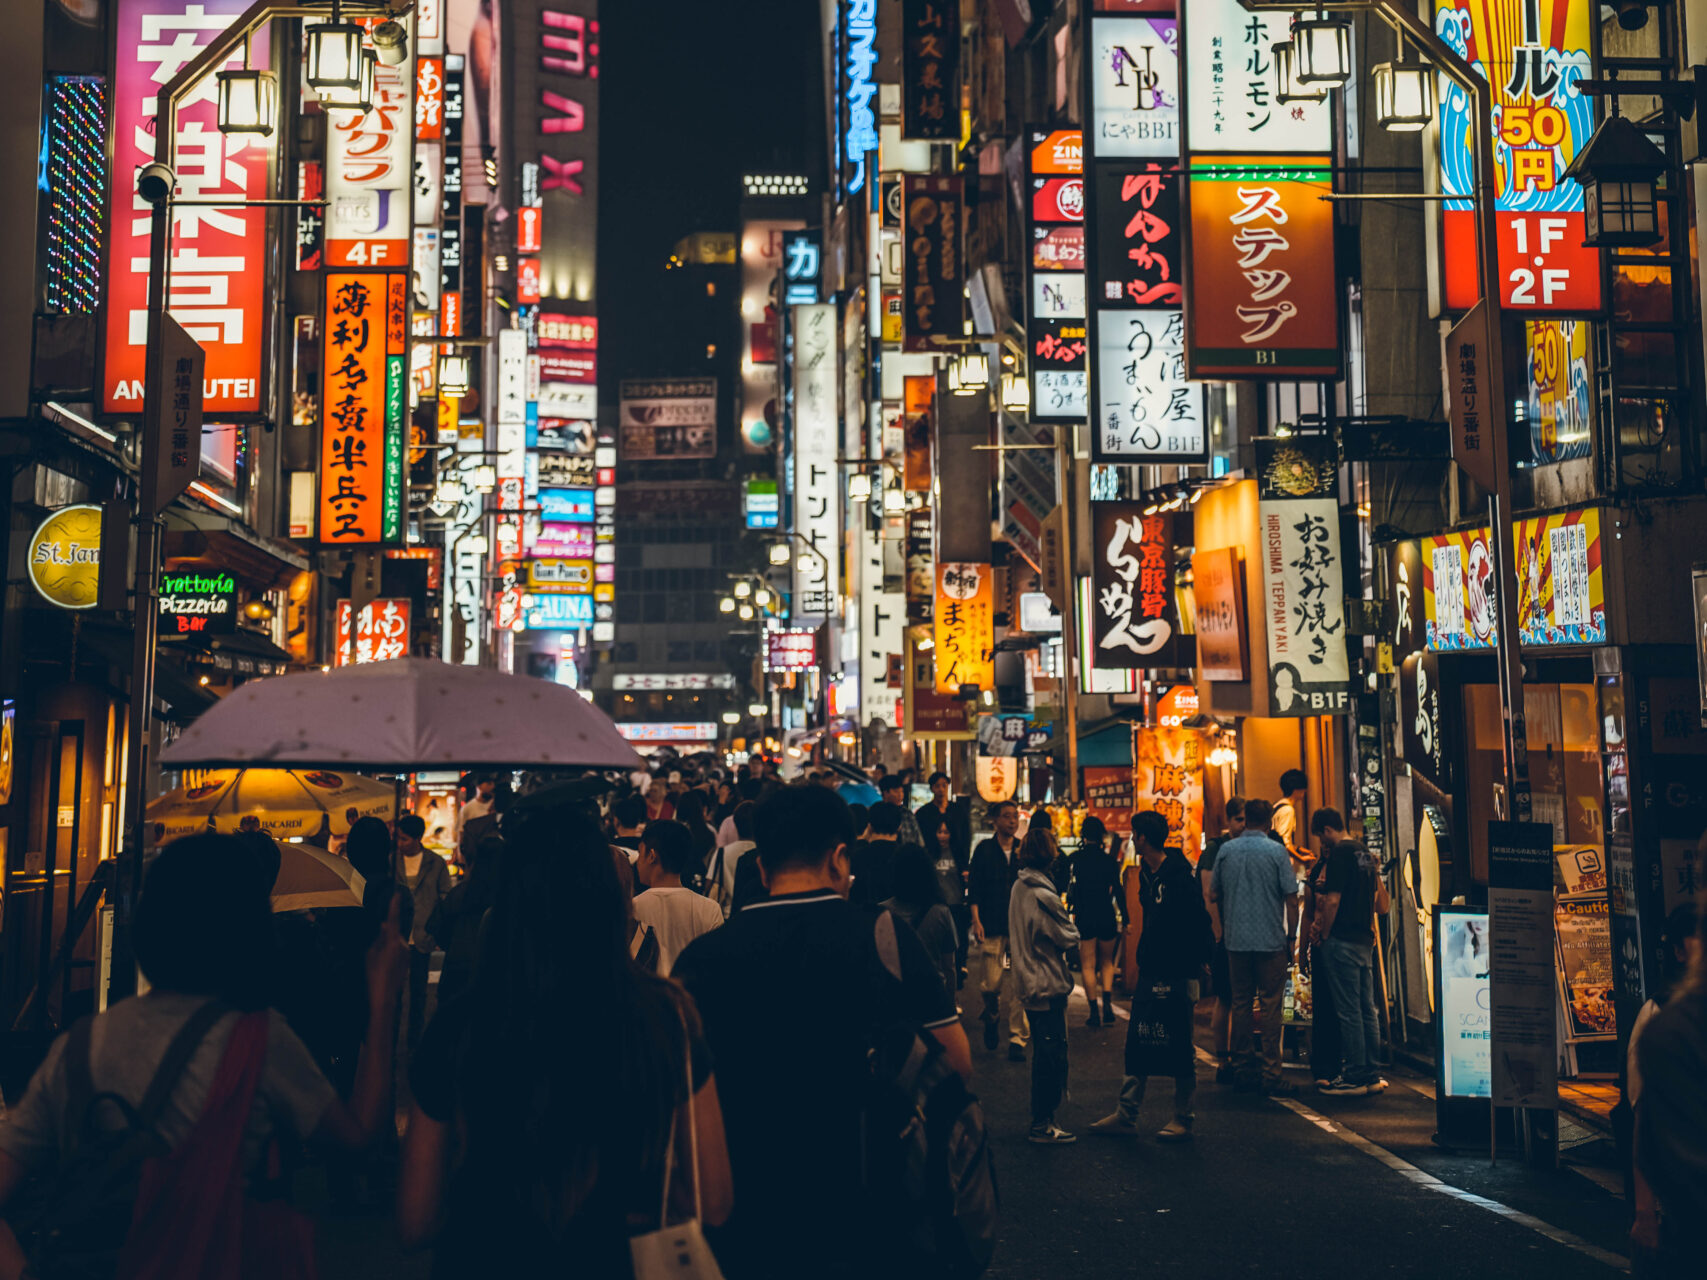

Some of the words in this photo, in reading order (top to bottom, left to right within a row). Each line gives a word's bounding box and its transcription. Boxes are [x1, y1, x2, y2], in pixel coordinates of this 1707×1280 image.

[1212, 36, 1225, 134] 創業昭和二十九年
[1500, 107, 1566, 147] 50
[1053, 145, 1083, 158] ZIN
[128, 5, 248, 346] 安楽亭
[1513, 149, 1555, 193] 円
[346, 242, 388, 266] 4F
[1510, 218, 1567, 254] 1F
[1229, 186, 1297, 343] ステップ
[1509, 269, 1569, 305] 2F
[1256, 351, 1276, 365] B1
[113, 379, 255, 400] ANUTEI
[1460, 343, 1480, 451] 劇場通り一番街
[172, 358, 193, 468] 劇場通り一番街
[1106, 402, 1122, 451] 一番街
[1168, 437, 1200, 451] B1F
[1267, 514, 1283, 574] HIROSHIMA
[159, 595, 227, 614] Pizzeria
[1290, 513, 1341, 664] お好み焼き
[177, 615, 208, 633] Bar
[1311, 690, 1348, 710] B1F
[166, 826, 194, 835] BACARDI
[262, 819, 303, 829] BACARDI
[1567, 902, 1609, 914] Cautio
